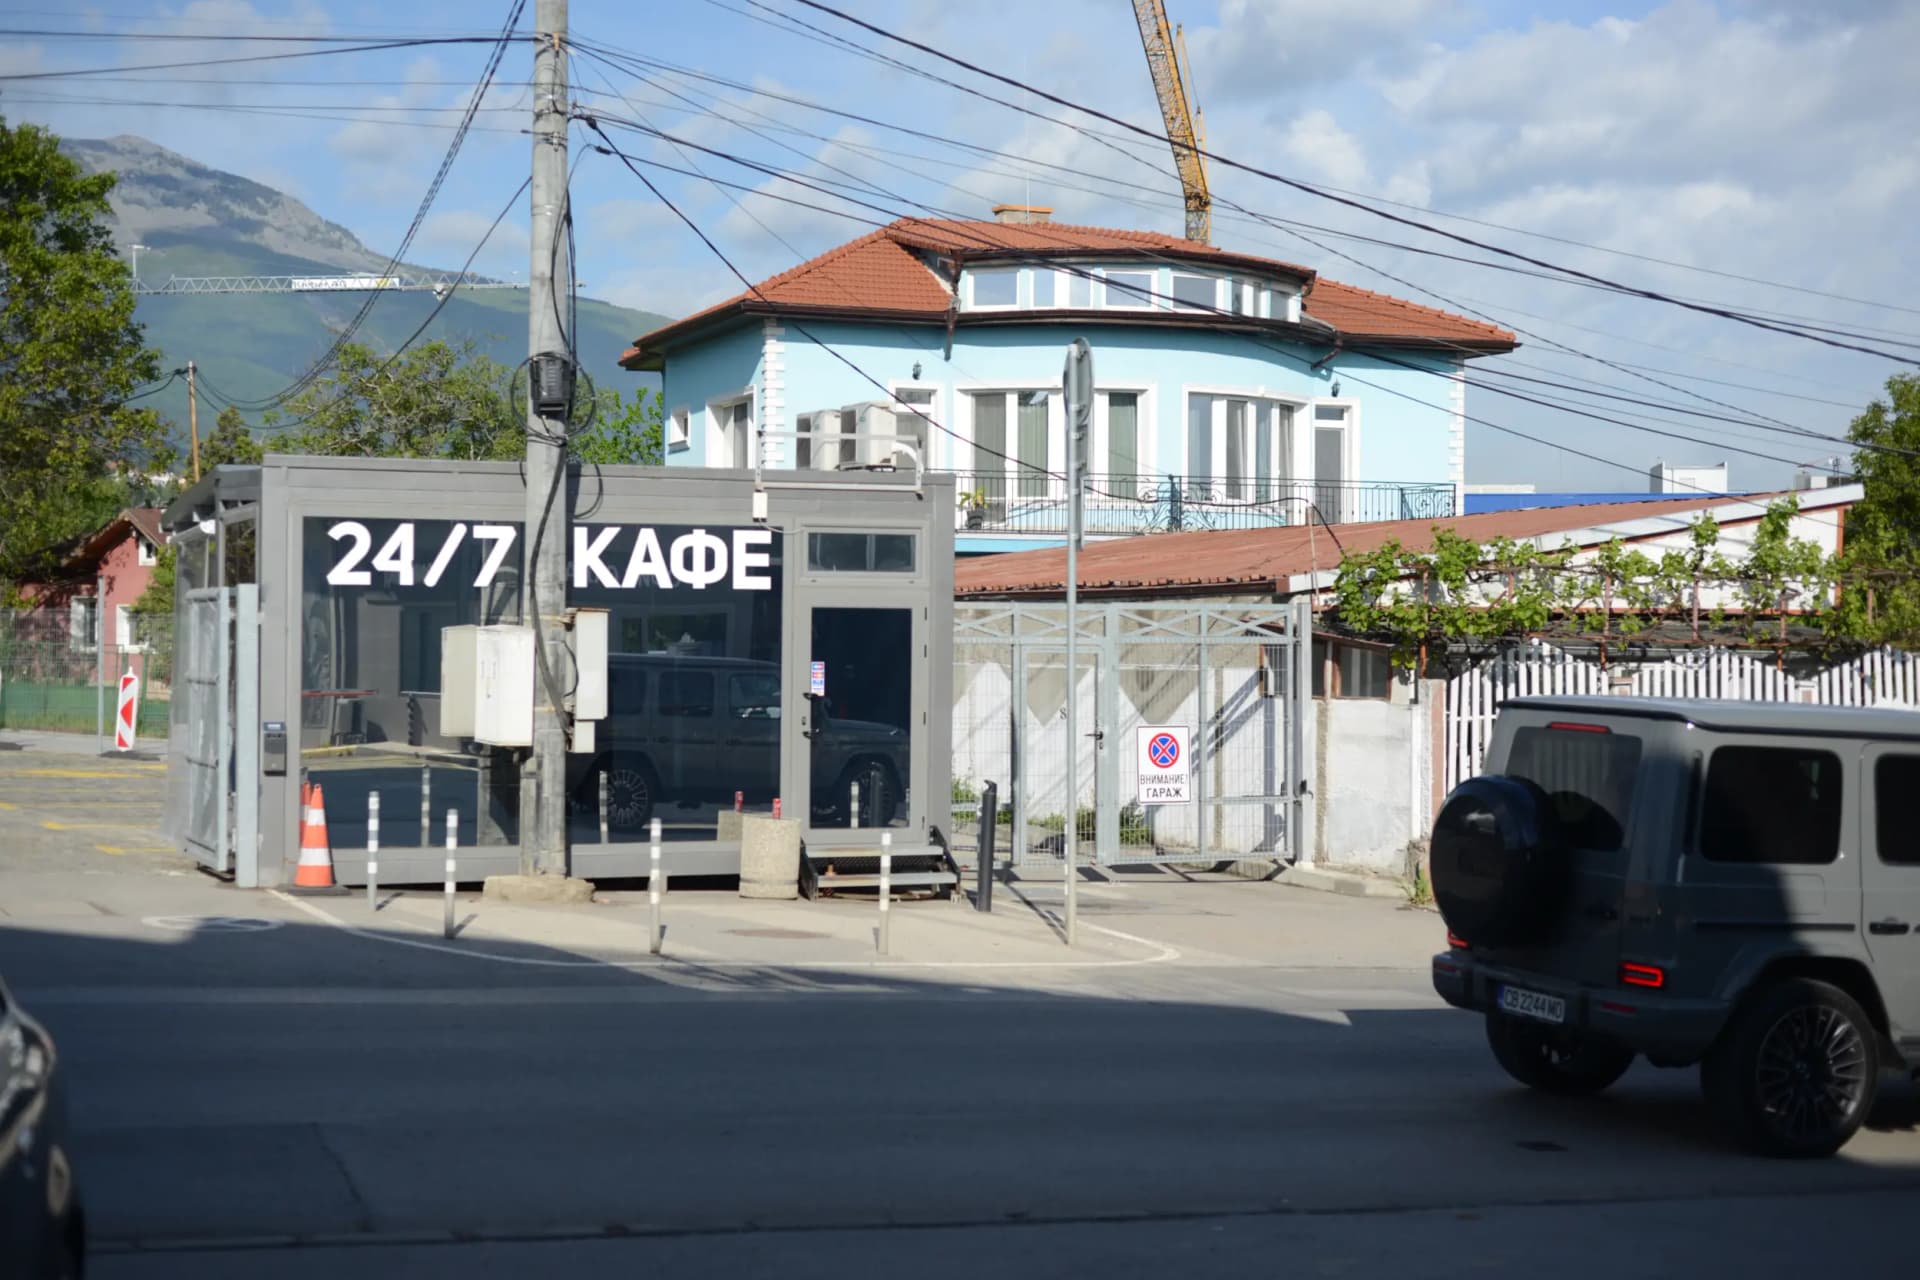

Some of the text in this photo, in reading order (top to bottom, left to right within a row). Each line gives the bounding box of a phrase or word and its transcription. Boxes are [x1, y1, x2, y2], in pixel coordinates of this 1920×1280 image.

[326, 521, 772, 590] 24/7 КАФЕ
[1146, 787, 1182, 798] ГАРАЖ
